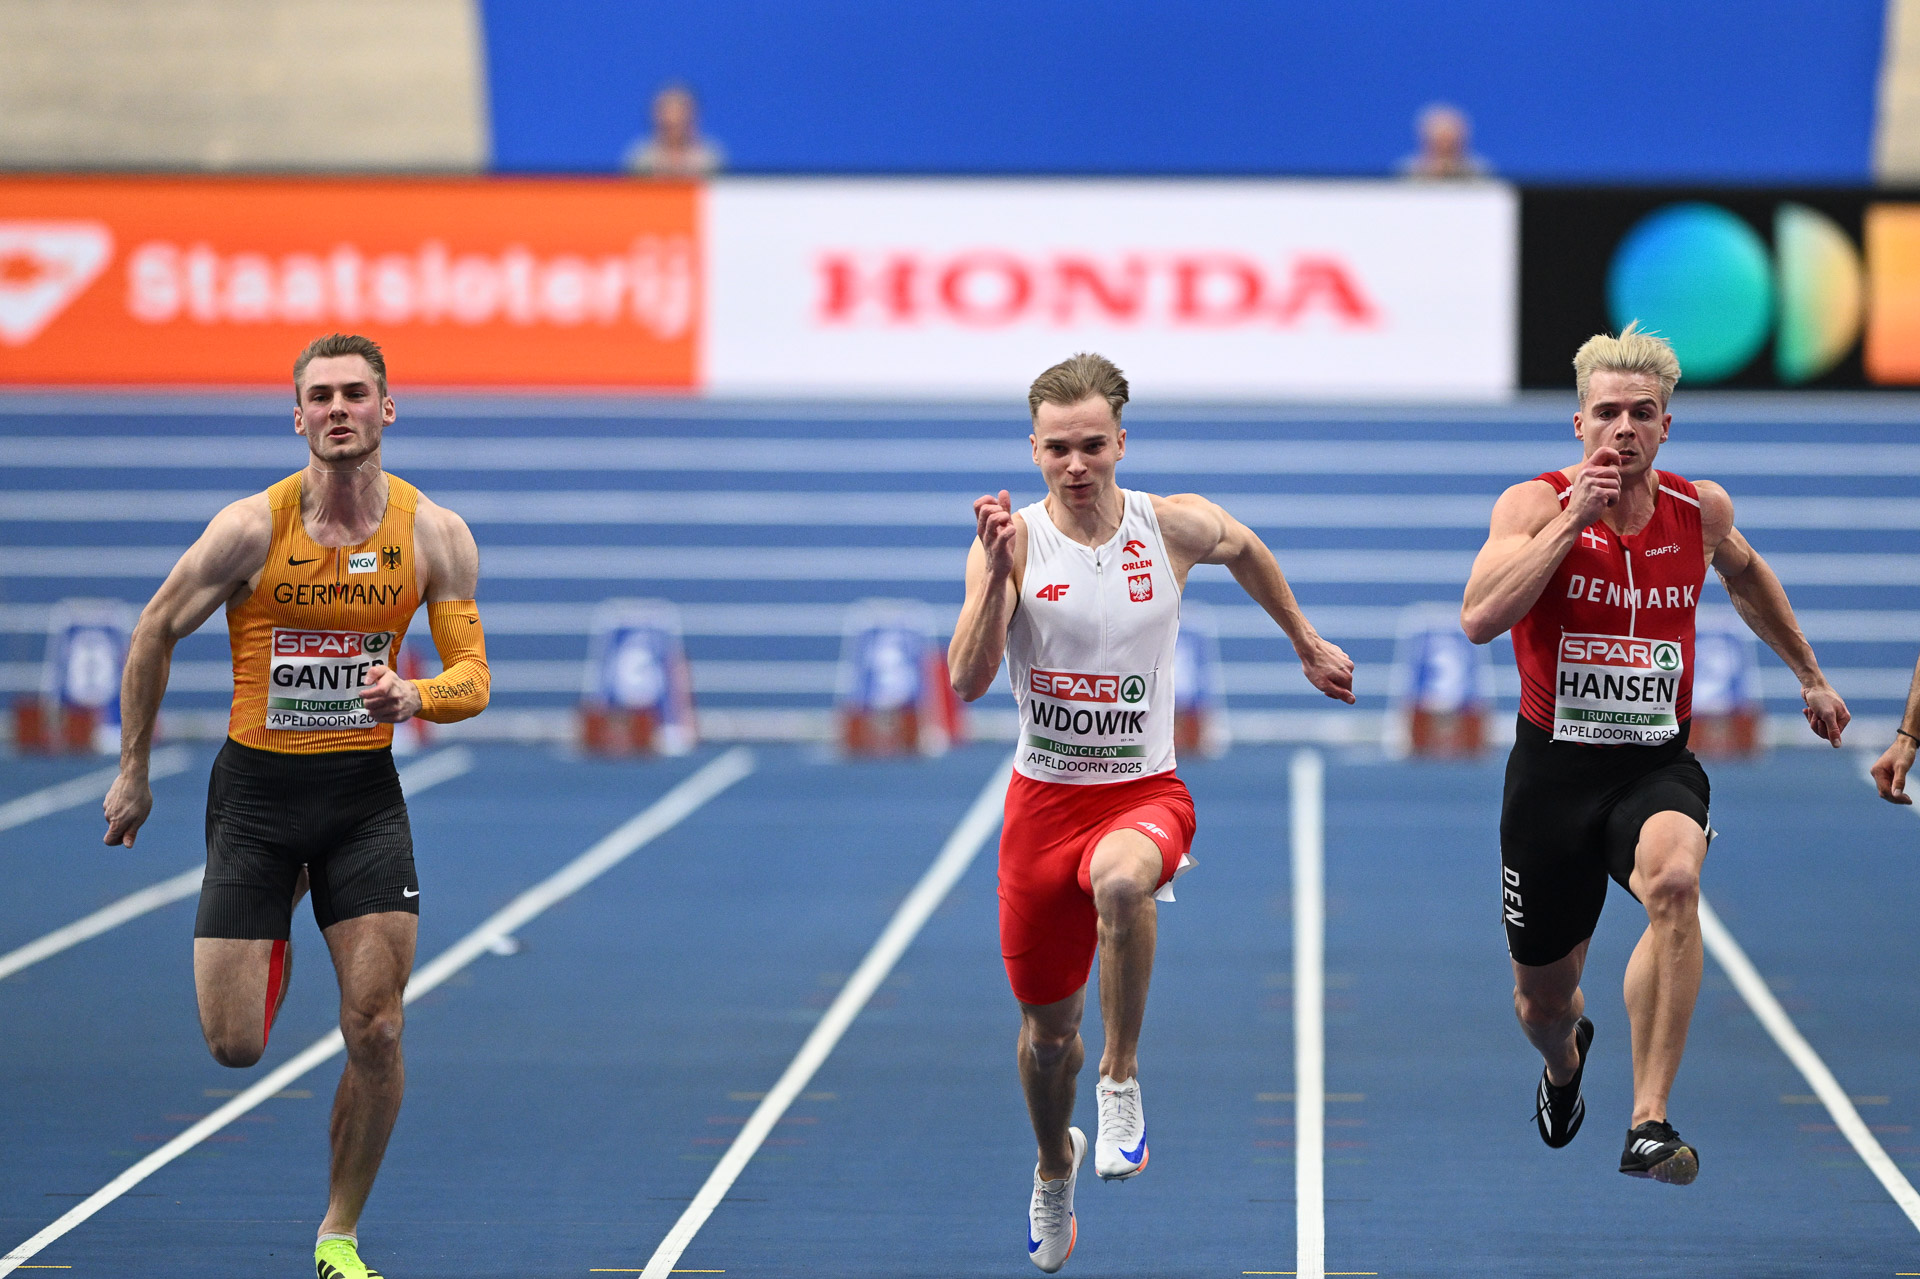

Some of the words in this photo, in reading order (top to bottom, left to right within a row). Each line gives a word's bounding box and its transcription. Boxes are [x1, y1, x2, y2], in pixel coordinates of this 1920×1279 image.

[128, 239, 693, 339] Staatsloterij
[817, 252, 1382, 328] HONDA
[1645, 545, 1673, 557] CRAFT
[349, 557, 376, 569] WGV
[1121, 559, 1153, 571] ORLEN
[274, 582, 403, 606] GERMANY
[1036, 584, 1070, 601] 4F
[1567, 574, 1695, 609] DENMARK
[277, 634, 361, 654] SPAR
[1562, 640, 1649, 665] SPAR
[429, 678, 477, 699] GERMANY
[1032, 673, 1117, 699] SPAR
[1560, 671, 1675, 703] HANSEN
[301, 701, 327, 711] RUN
[328, 699, 363, 711] CLEAN
[271, 713, 358, 727] APELDOORN
[1030, 699, 1146, 736] WDOWIK
[1588, 711, 1613, 722] RUN
[1560, 724, 1643, 742] APELDOORN
[1645, 729, 1675, 742] 2025
[1054, 743, 1078, 755] RUN
[1027, 752, 1108, 773] APELDOORN
[1111, 762, 1142, 774] 2025
[1136, 821, 1169, 840] 4F
[1504, 865, 1525, 928] DEN
